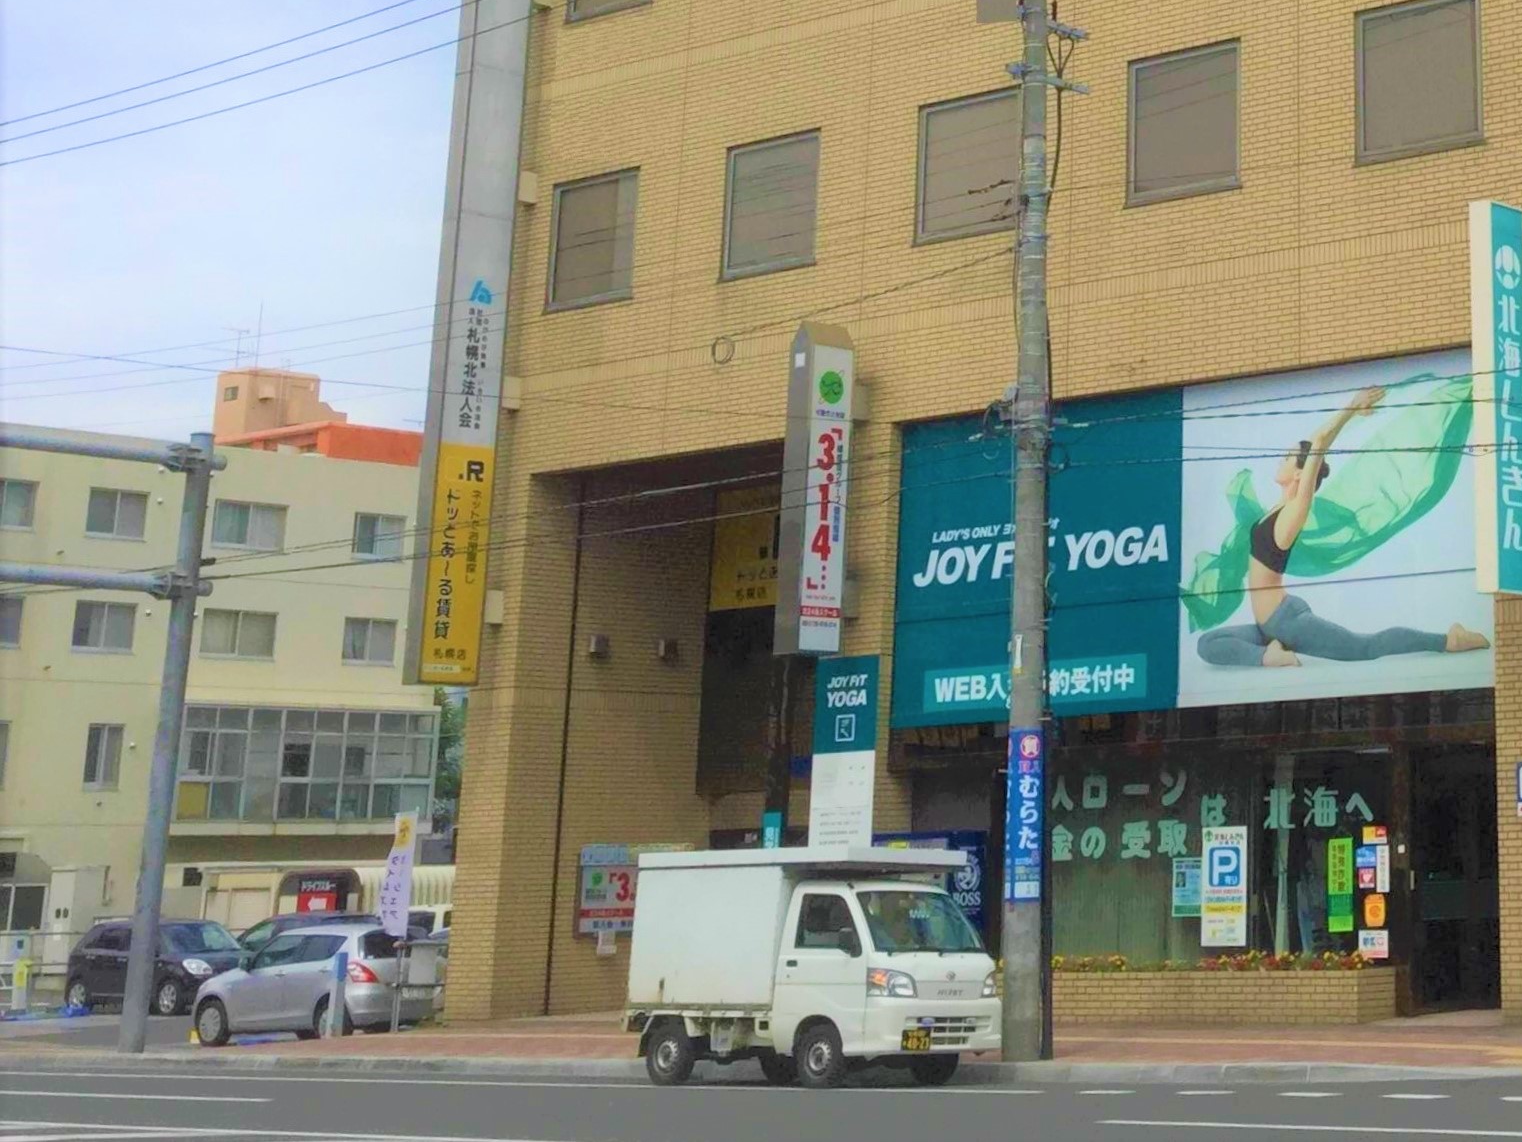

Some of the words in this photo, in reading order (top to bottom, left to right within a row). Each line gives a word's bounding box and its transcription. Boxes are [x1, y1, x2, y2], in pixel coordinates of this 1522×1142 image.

[931, 528, 971, 544] LADY'S
[971, 524, 1002, 540] ONLY
[913, 544, 992, 588] JOY
[1064, 524, 1168, 571] YOGA
[827, 689, 867, 708] YOGA
[934, 663, 1136, 708] WEB入約受付中
[1018, 775, 1040, 850] むらた
[1211, 849, 1238, 886] P
